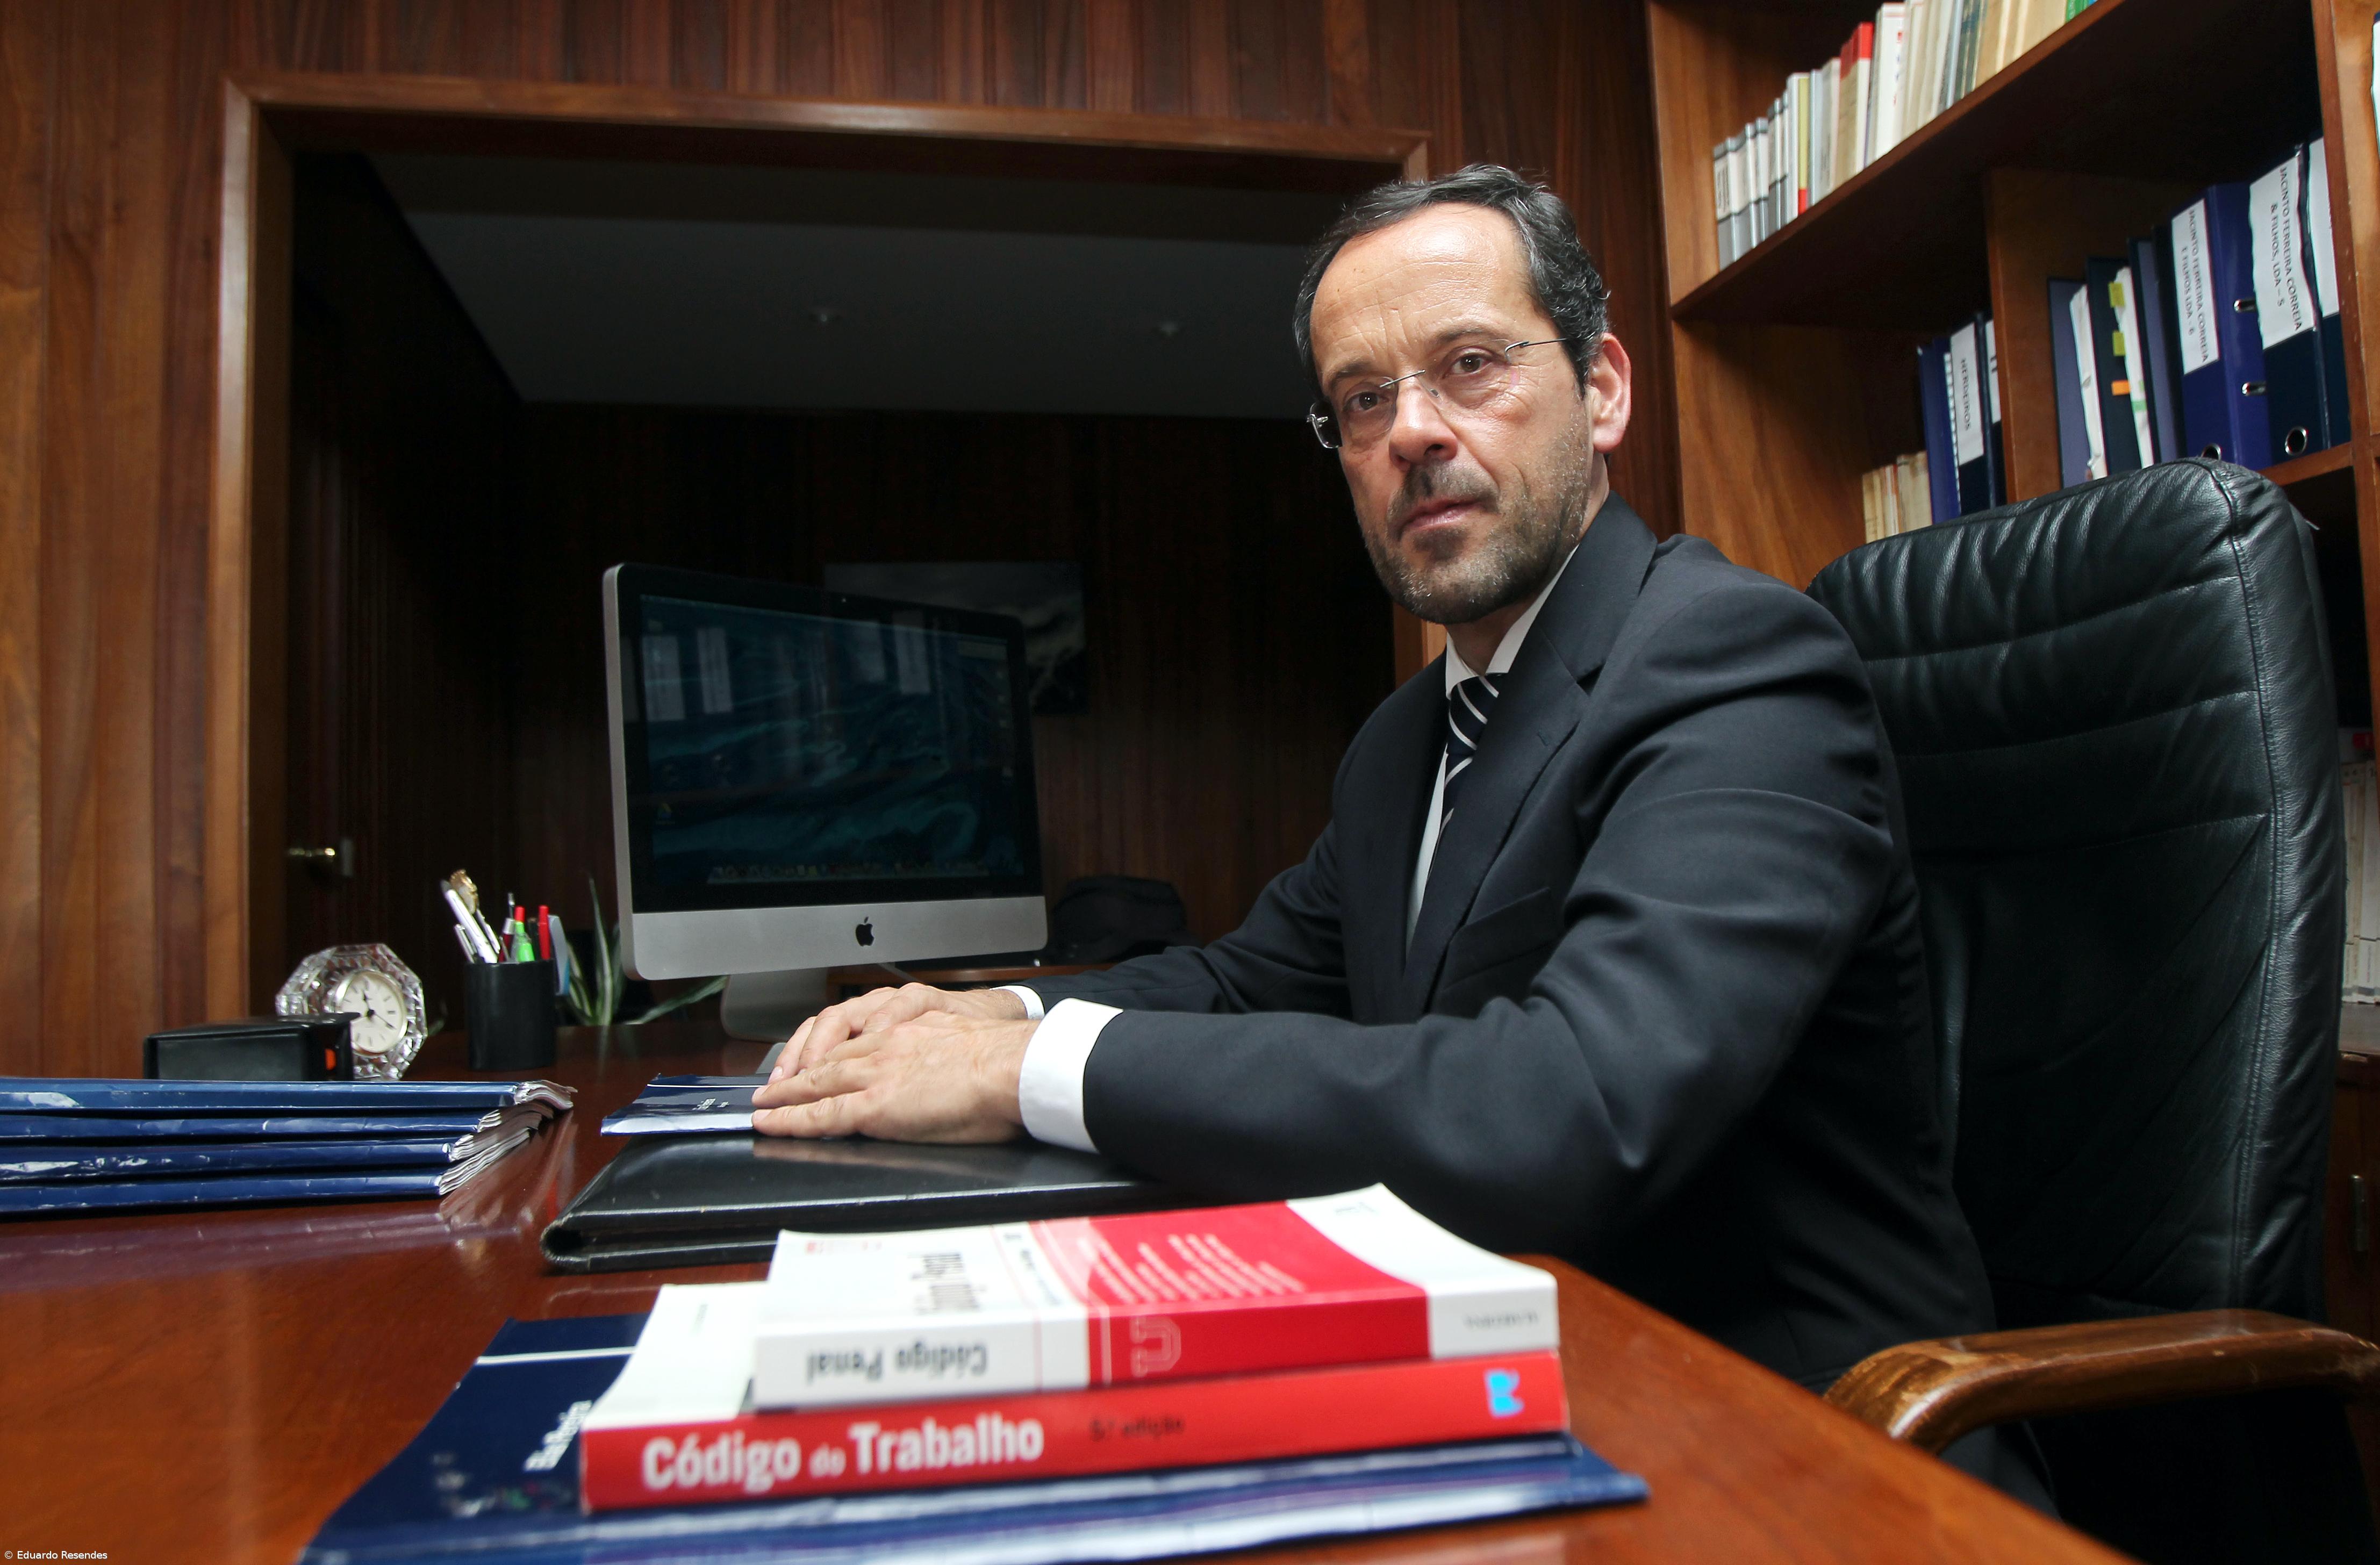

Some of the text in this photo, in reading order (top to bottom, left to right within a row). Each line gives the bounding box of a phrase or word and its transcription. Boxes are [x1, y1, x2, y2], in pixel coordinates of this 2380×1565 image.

[2270, 204, 2278, 213] &
[2270, 216, 2279, 261] FILHOS,
[2279, 167, 2302, 331] JACINTO FERREIRA CORREIA
[2182, 256, 2192, 295] FILHOS
[2189, 210, 2209, 363] JACINTO FERREIRA CORREIA
[2273, 261, 2282, 288] LDA
[1961, 358, 1972, 431] HERDEIROS
[806, 1337, 988, 1385] Código Penal
[643, 1430, 801, 1494] Código
[810, 1444, 846, 1477] do
[849, 1413, 1044, 1474] Trabalho
